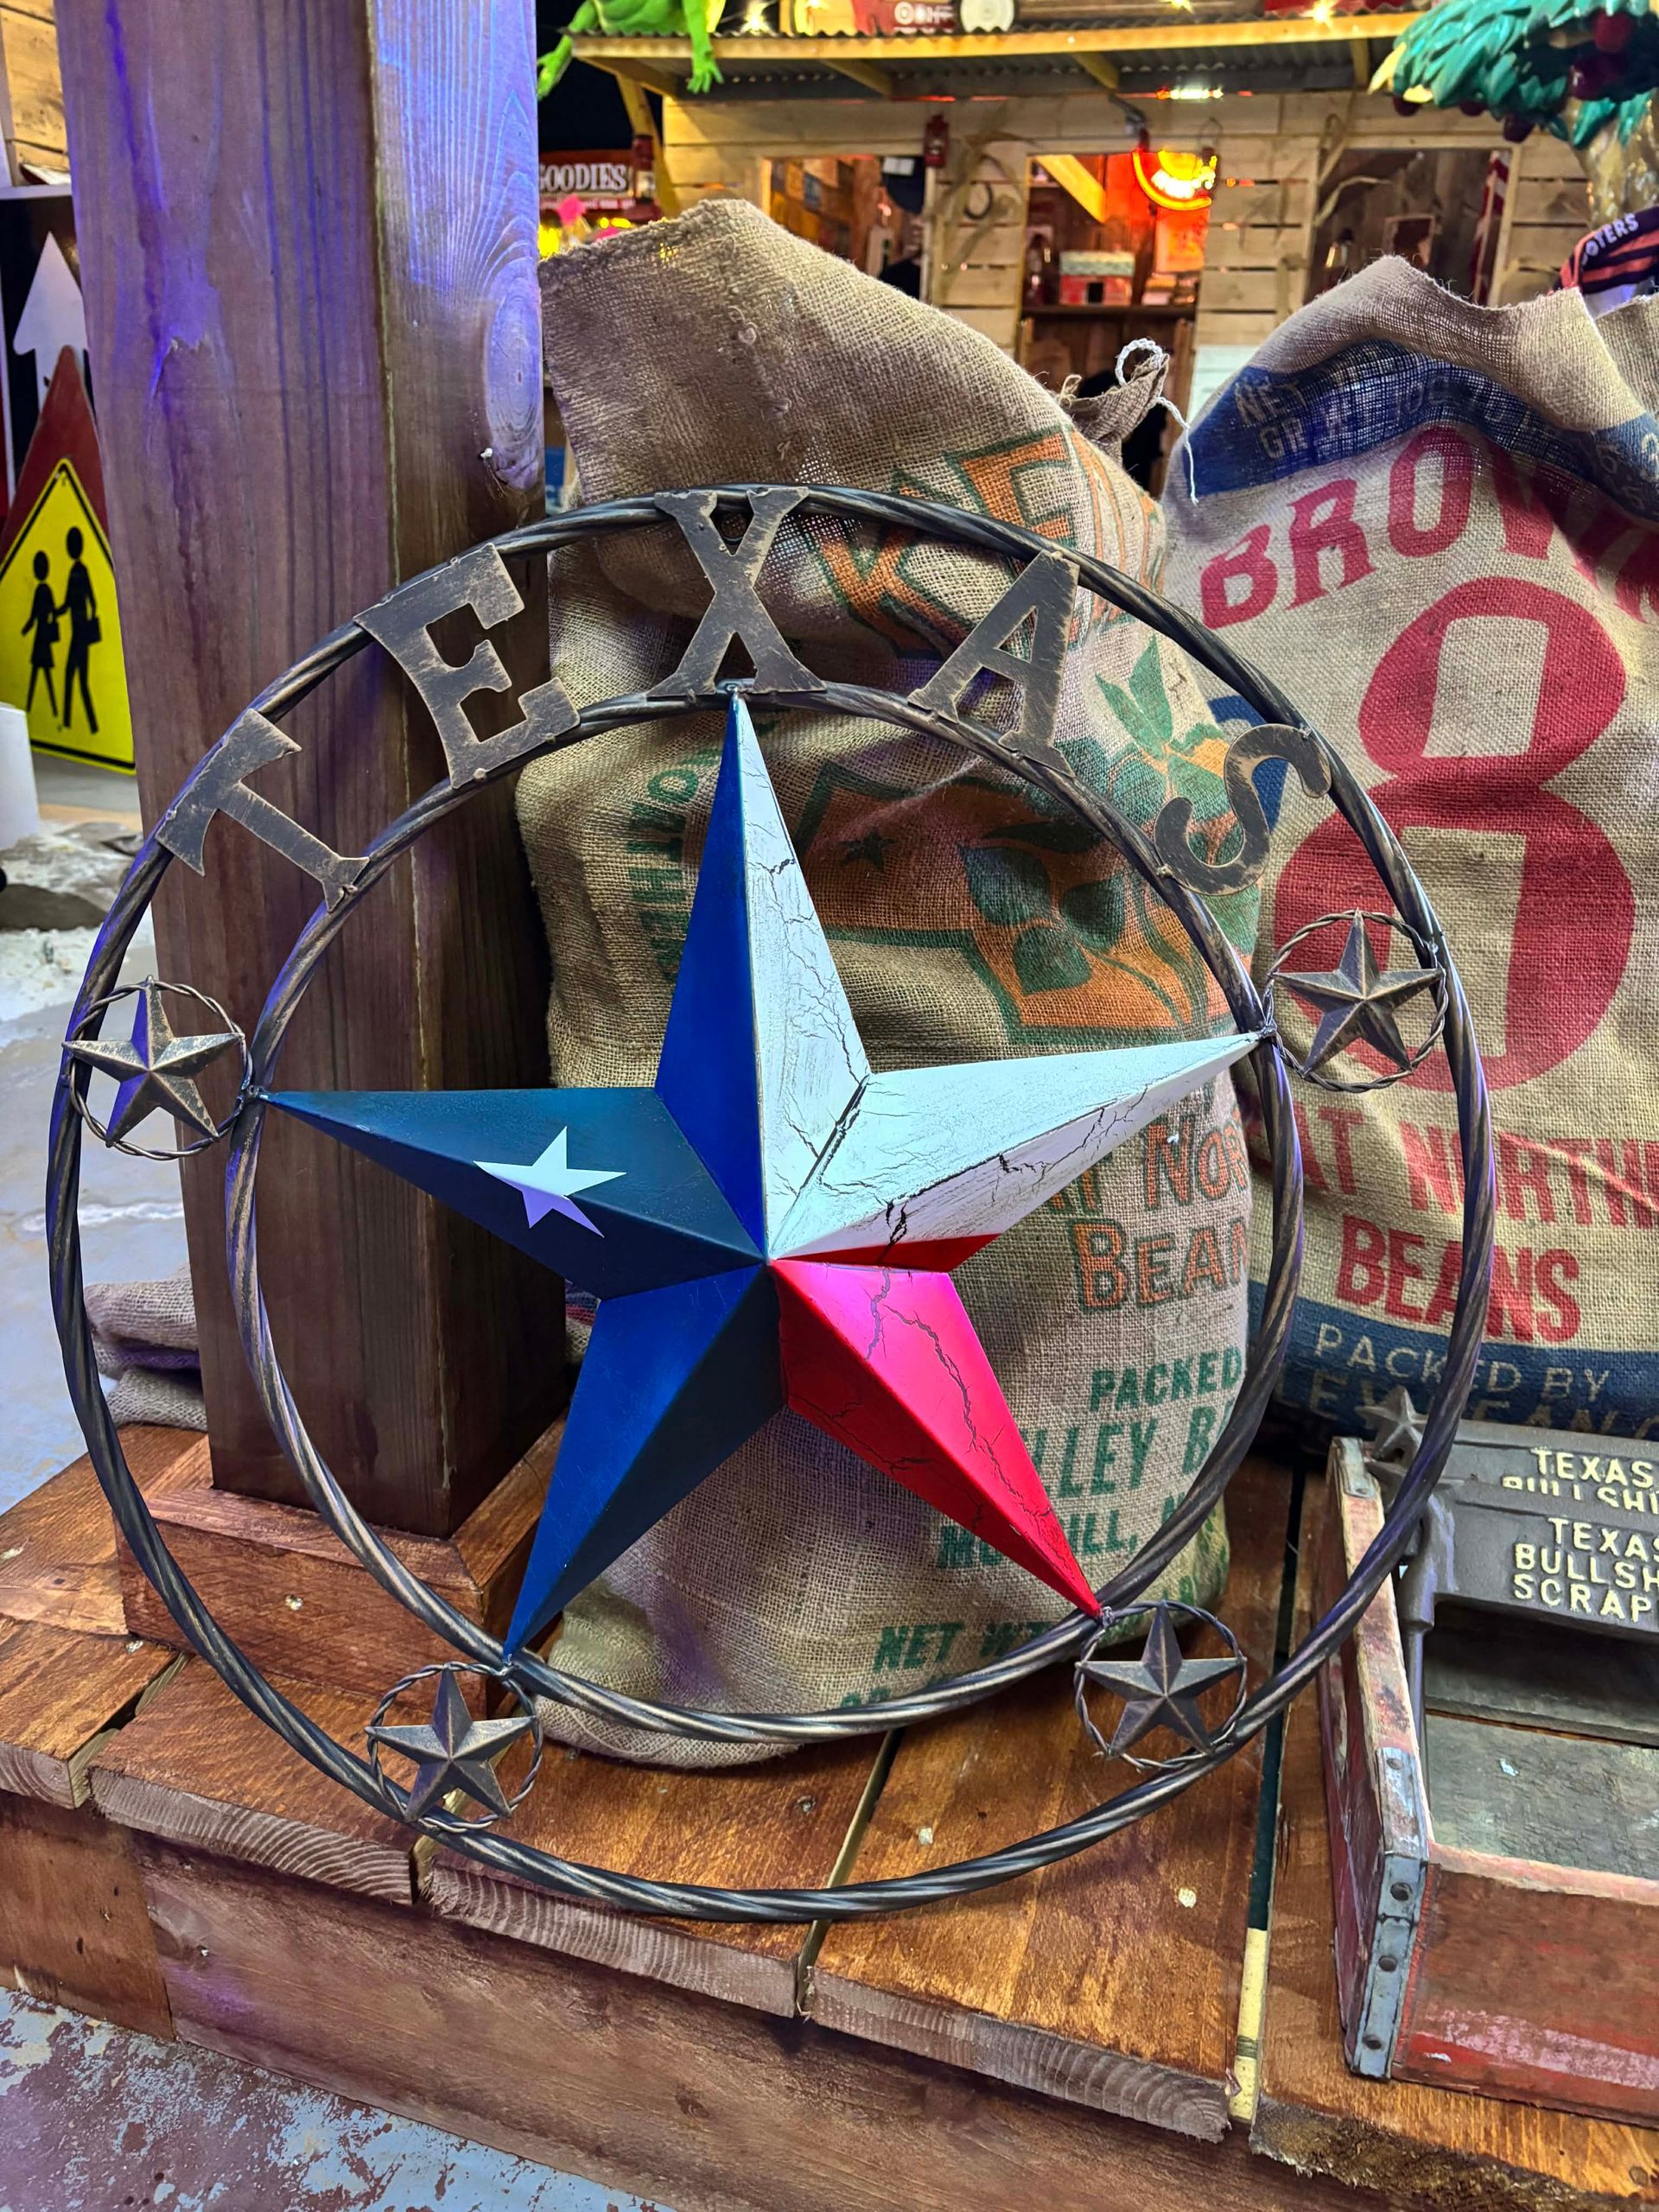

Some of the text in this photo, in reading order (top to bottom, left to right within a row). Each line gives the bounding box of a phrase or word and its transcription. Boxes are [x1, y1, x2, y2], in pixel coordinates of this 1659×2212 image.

[156, 486, 1333, 912] TEXAS
[1090, 1346, 1243, 1412] PACKED
[1313, 1323, 1610, 1402] PACKD BY
[1529, 1446, 1654, 1489] TEXAS
[1513, 1573, 1652, 1624] SCRAP
[873, 1621, 964, 1674] NET
